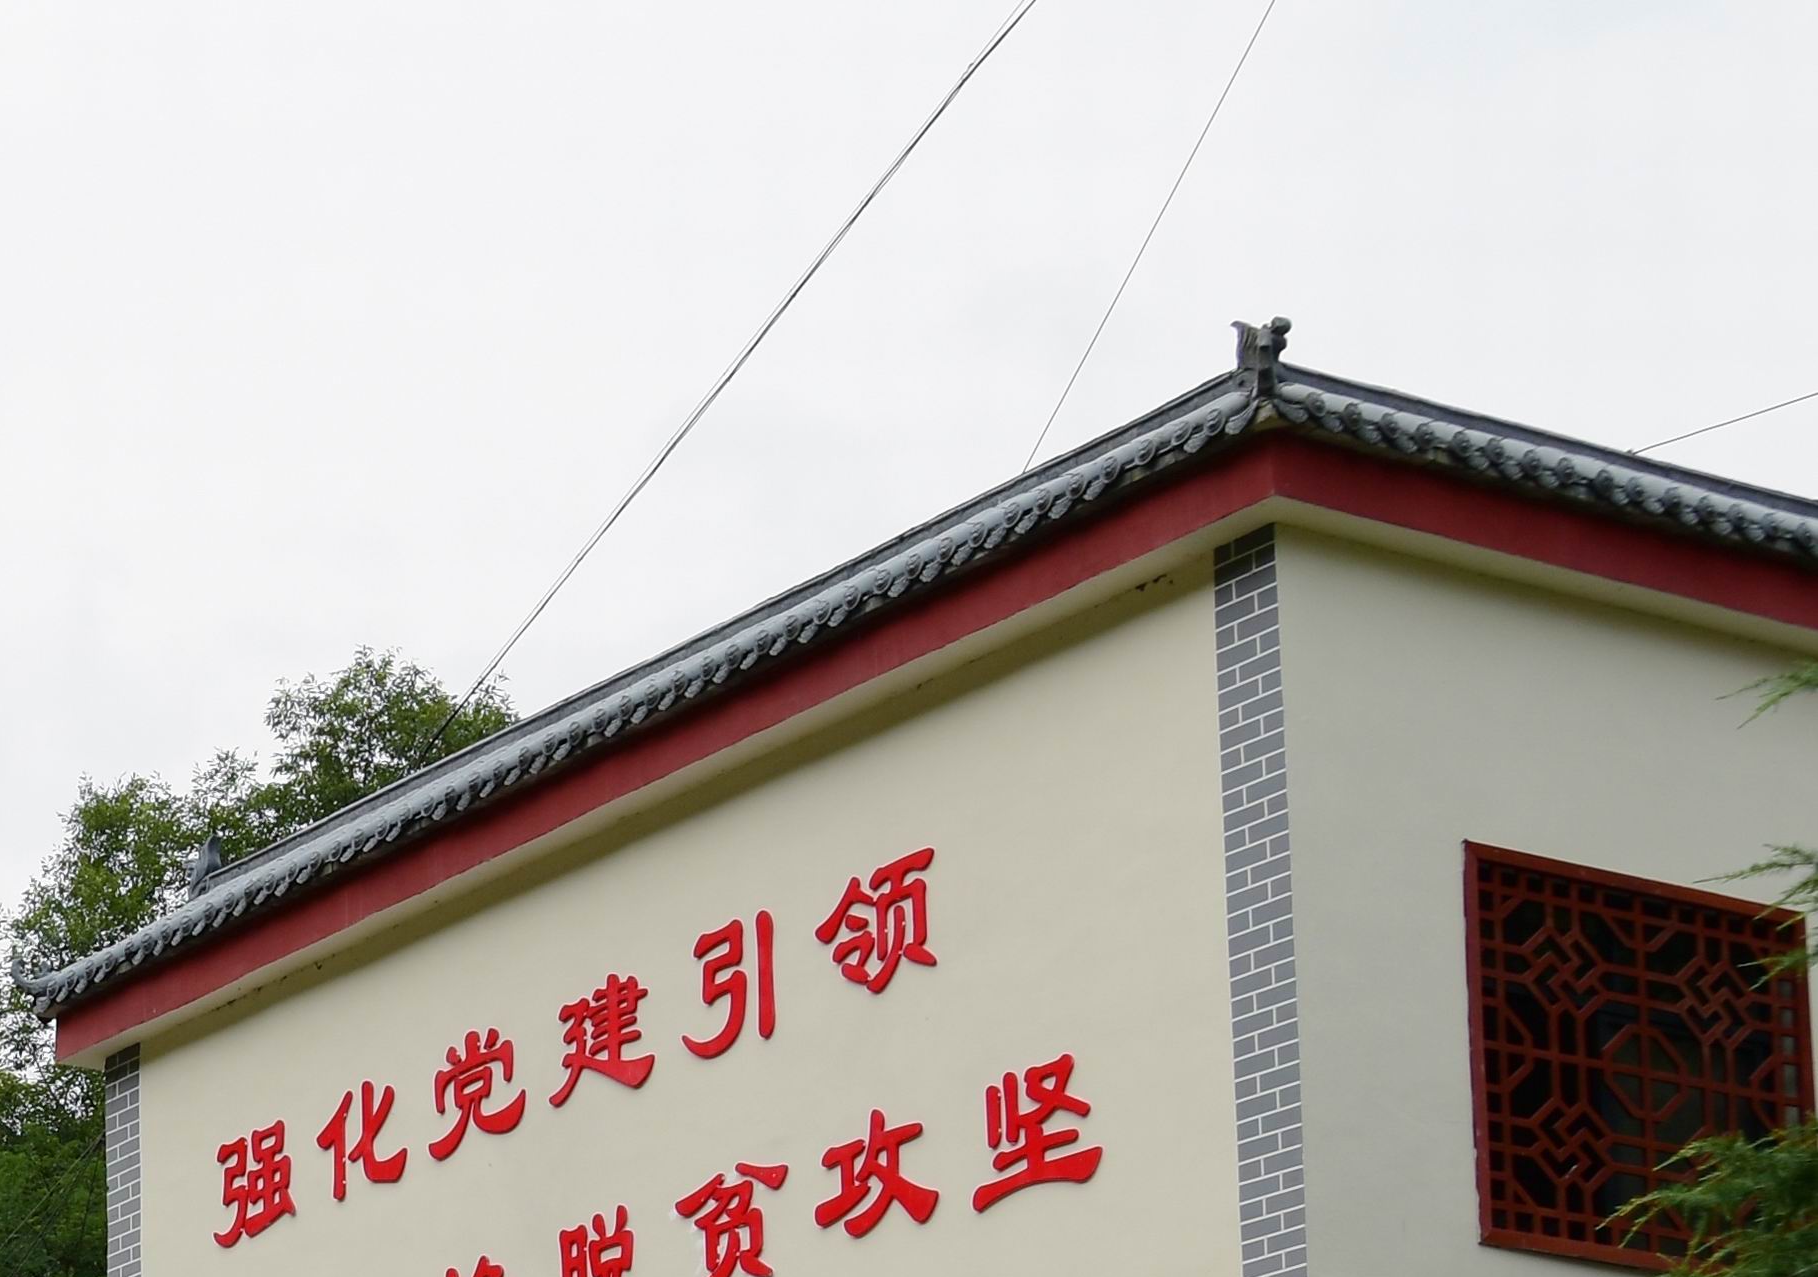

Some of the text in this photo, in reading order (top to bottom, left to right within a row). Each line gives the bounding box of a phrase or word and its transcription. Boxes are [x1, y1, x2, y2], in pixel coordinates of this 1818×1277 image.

[214, 847, 938, 1249] 强化党建引领
